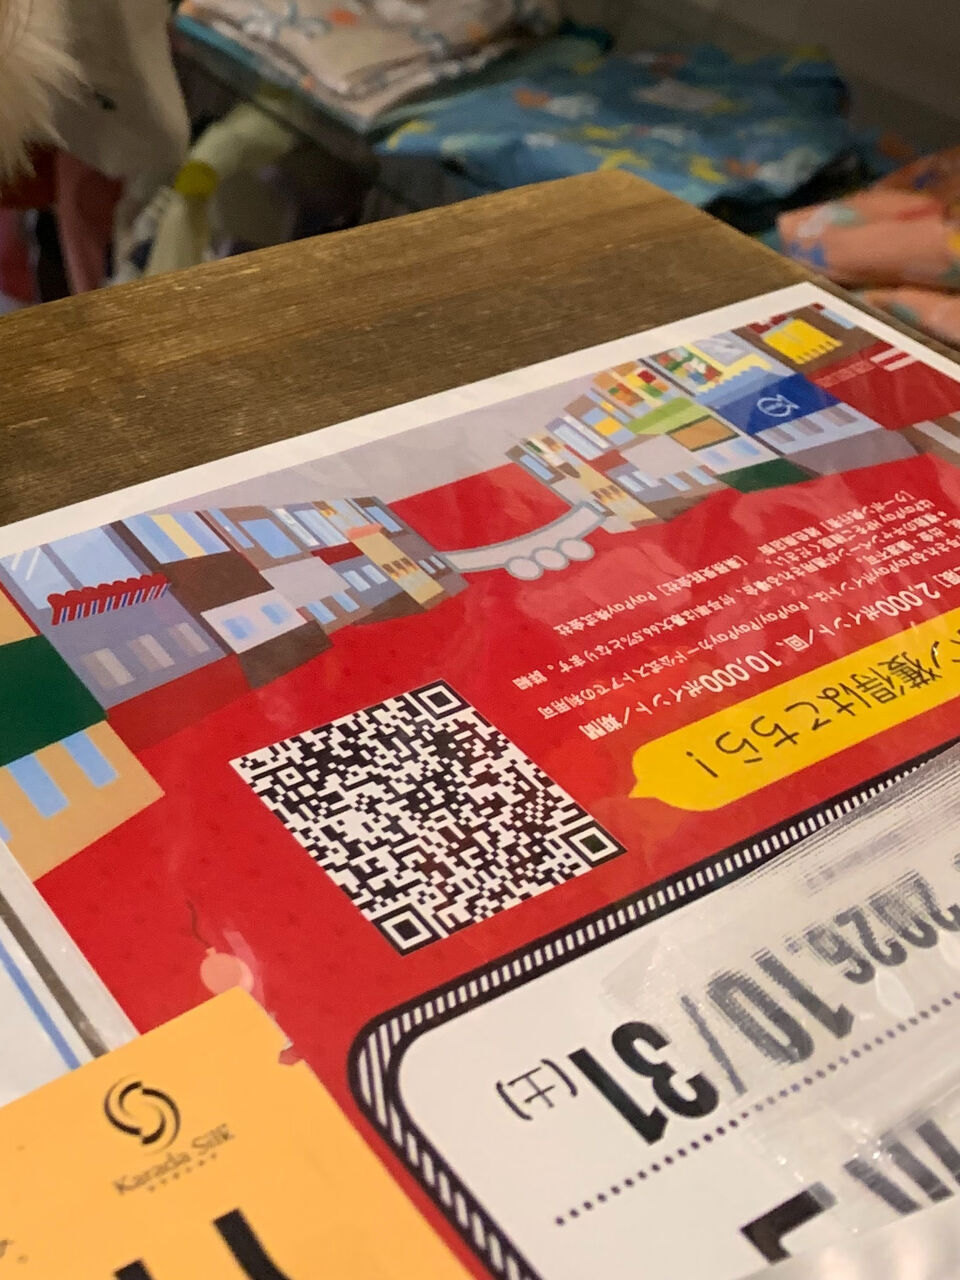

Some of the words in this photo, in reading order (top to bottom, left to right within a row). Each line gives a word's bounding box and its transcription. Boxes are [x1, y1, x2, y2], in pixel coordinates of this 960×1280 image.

[686, 629, 960, 778] ン獲得はこちら！
